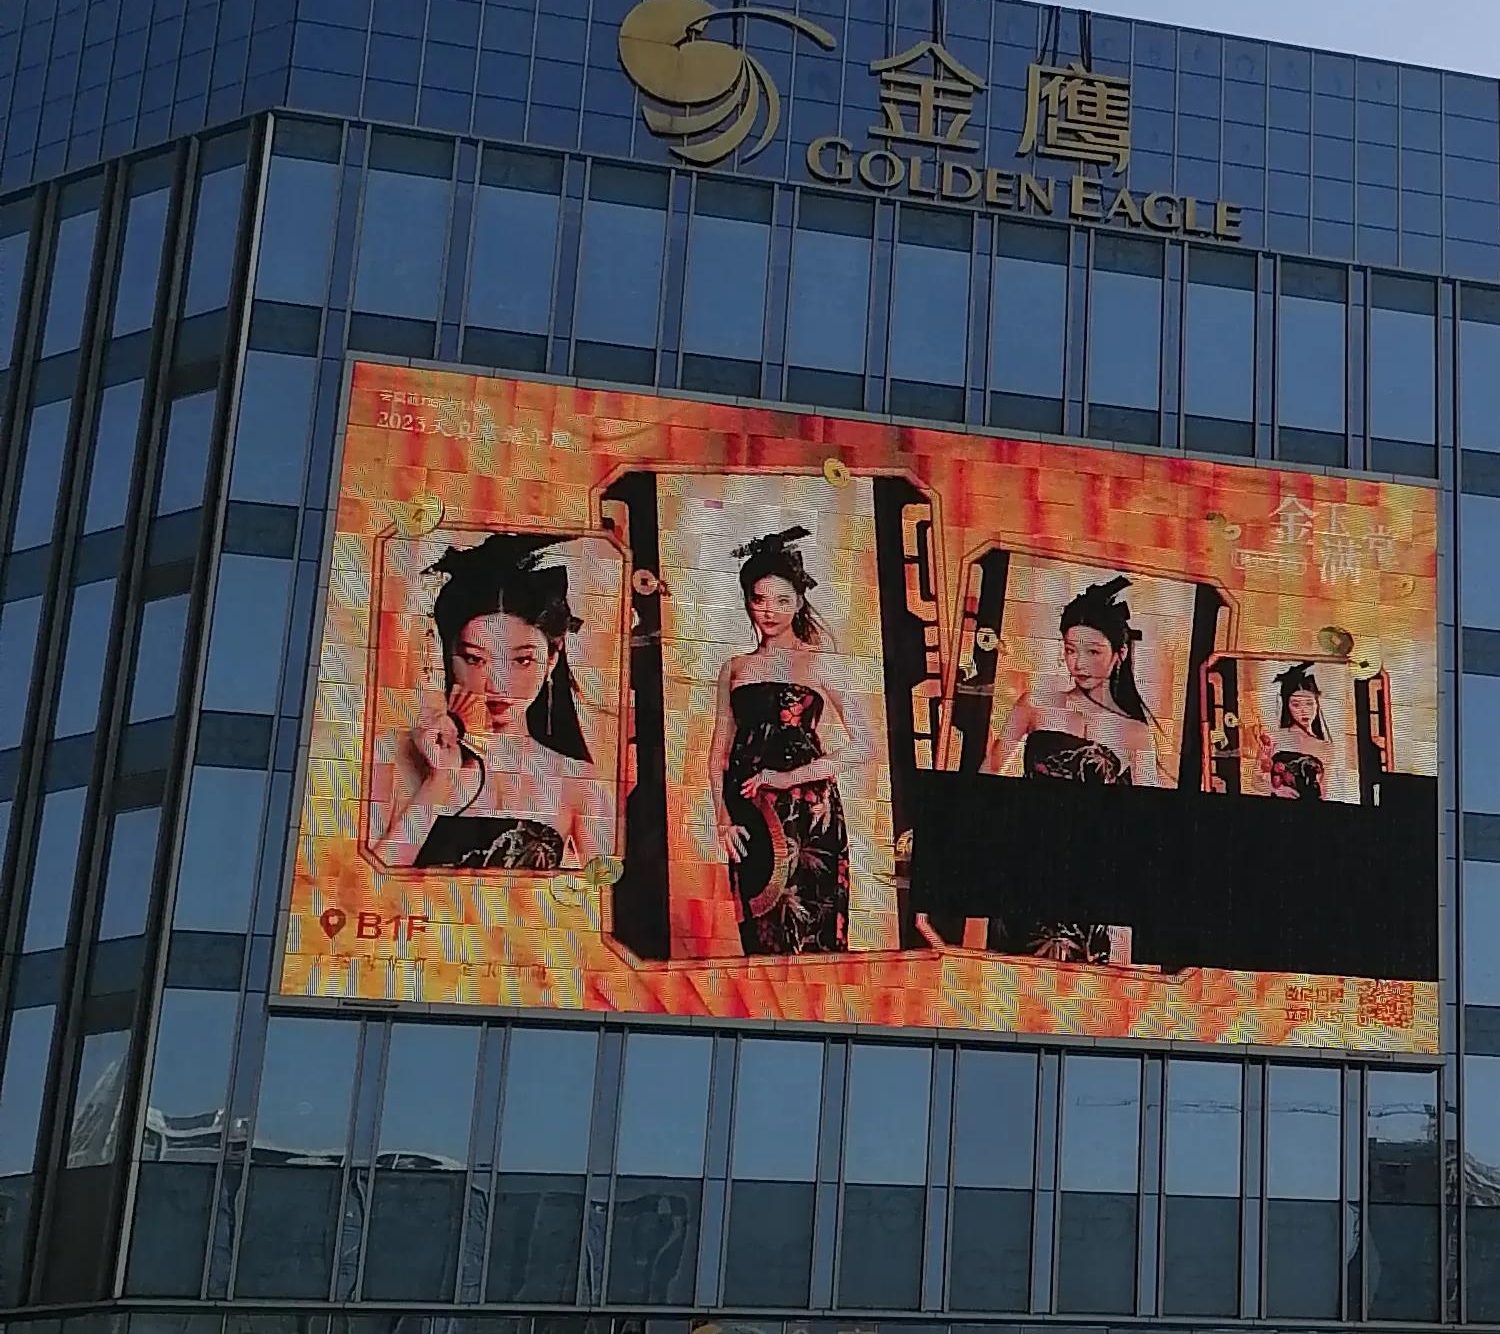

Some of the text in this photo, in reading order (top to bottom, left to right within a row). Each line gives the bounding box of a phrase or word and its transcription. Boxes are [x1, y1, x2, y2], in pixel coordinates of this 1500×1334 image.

[869, 40, 1131, 175] 金鹰
[806, 136, 1242, 242] GOLDEN EAGLE
[357, 911, 429, 942] B1F
